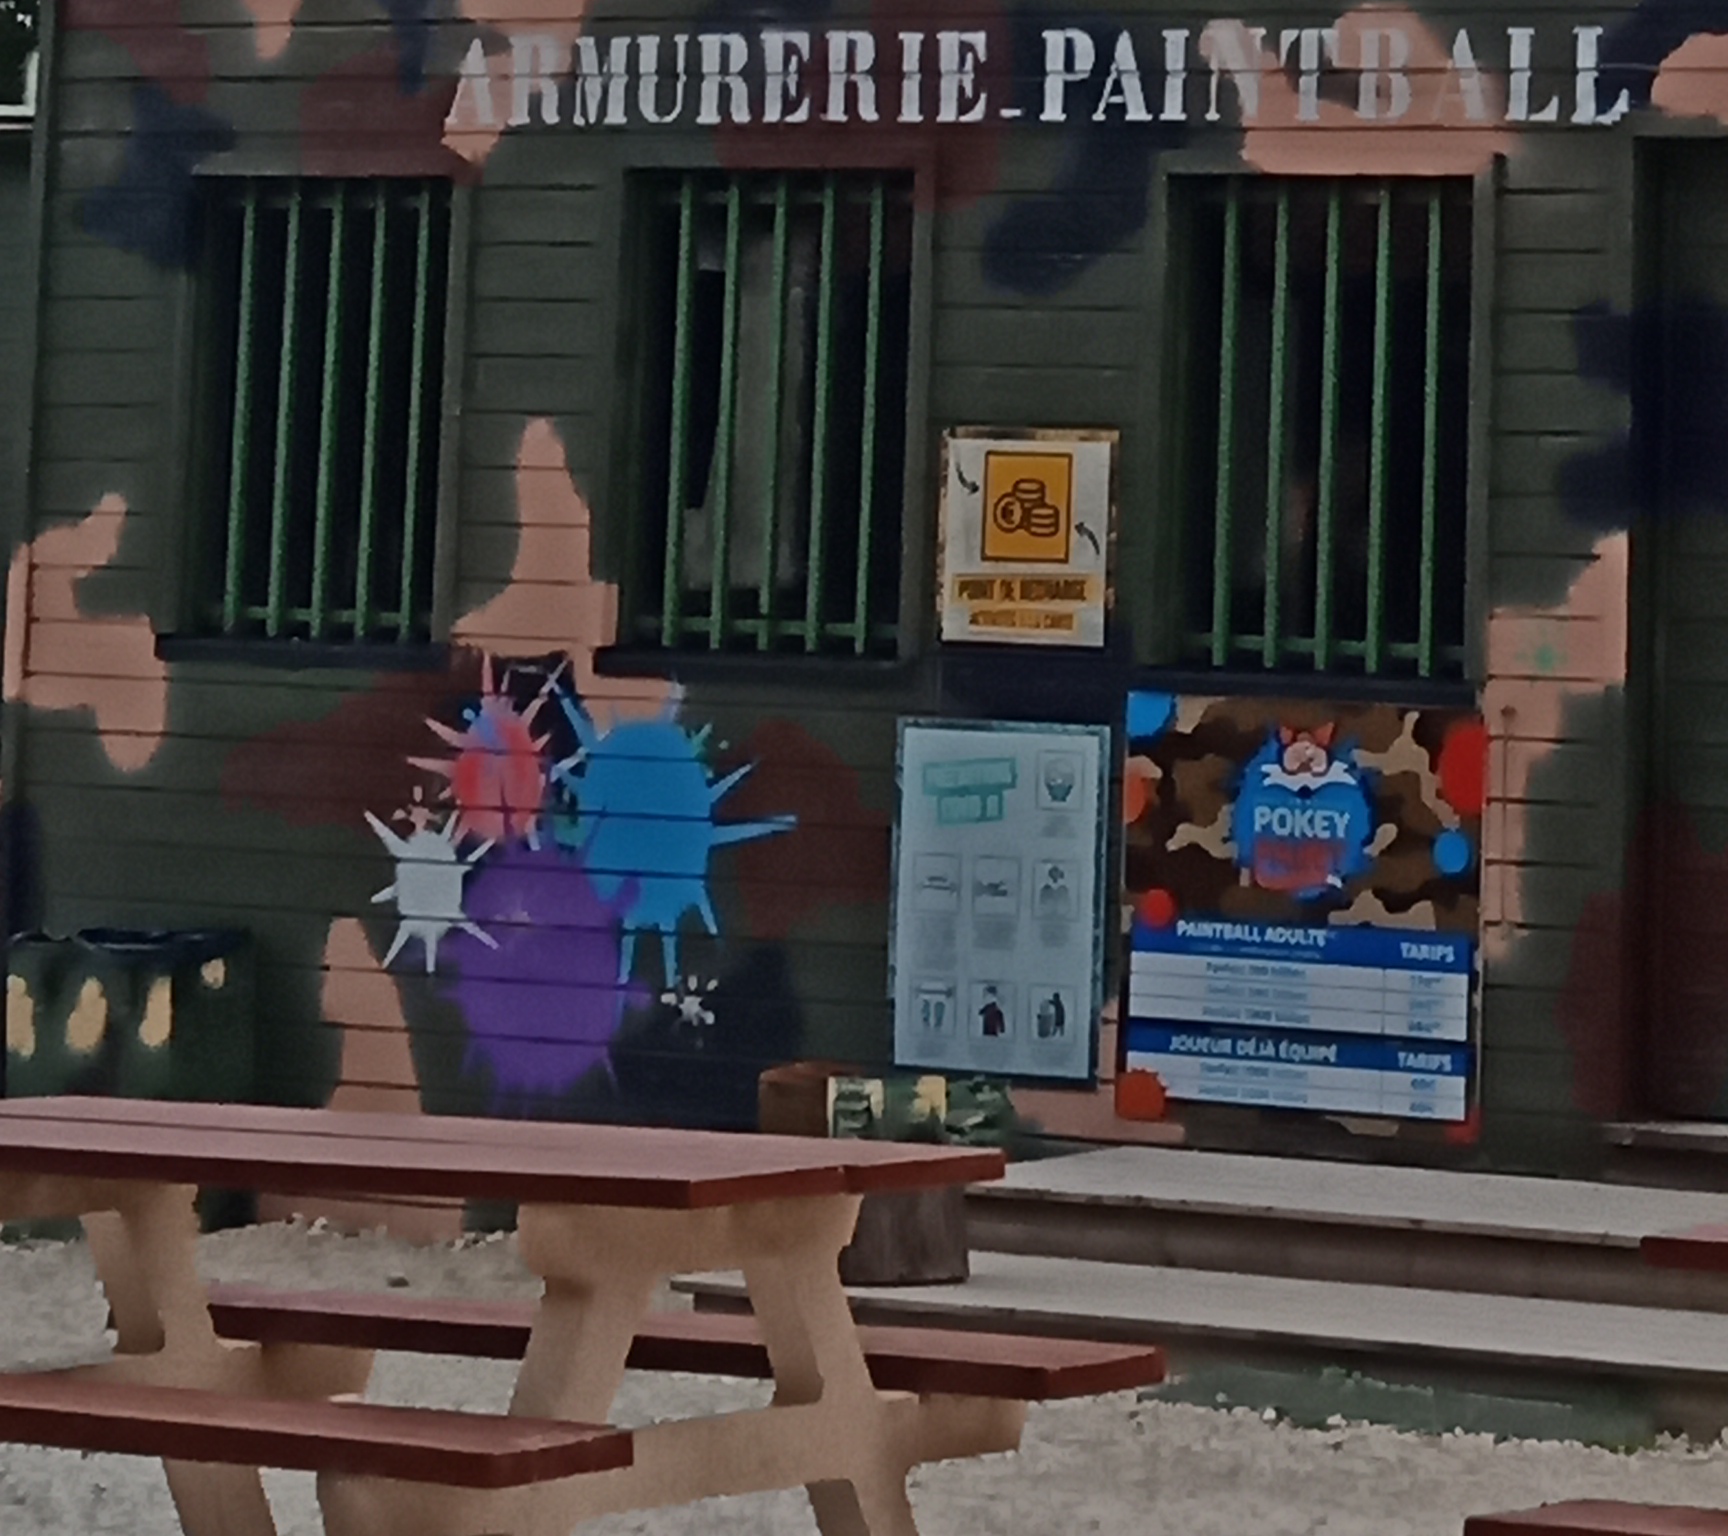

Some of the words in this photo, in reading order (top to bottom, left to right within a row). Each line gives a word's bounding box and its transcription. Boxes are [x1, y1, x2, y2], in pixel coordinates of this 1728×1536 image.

[1254, 805, 1350, 839] POKEY
[1176, 919, 1261, 943] PAINTBALL
[1400, 942, 1455, 963] TARIFS
